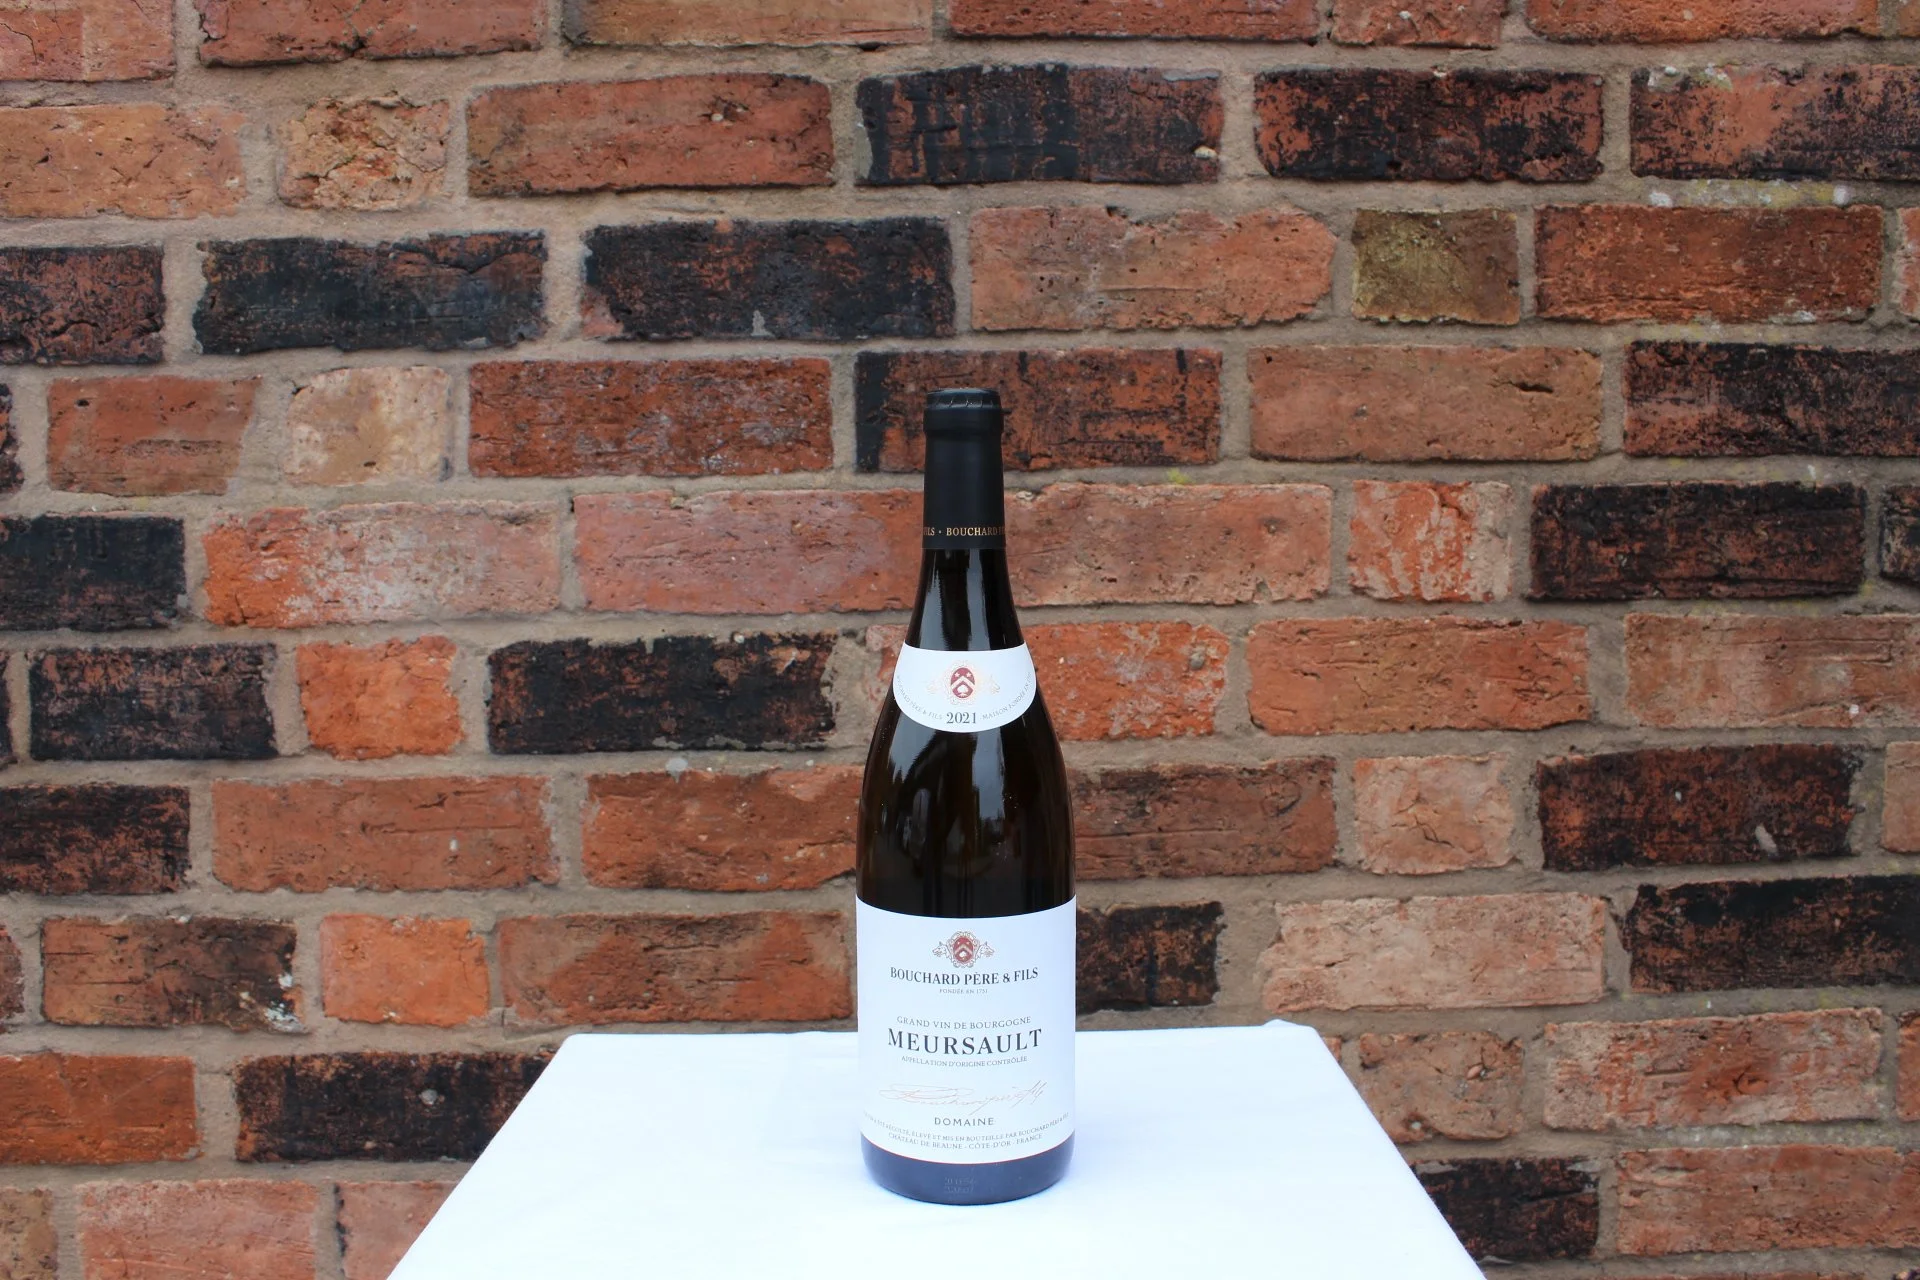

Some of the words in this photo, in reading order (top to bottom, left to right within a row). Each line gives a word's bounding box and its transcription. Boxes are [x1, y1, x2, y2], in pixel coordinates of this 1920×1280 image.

[946, 527, 998, 536] BOUCHARD
[946, 711, 976, 724] 2021
[982, 705, 1008, 719] MAISON
[890, 966, 961, 985] BOUCHARD
[964, 972, 999, 985] PÈRE
[1002, 973, 1011, 983] &
[1014, 966, 1039, 982] FILS
[896, 1015, 930, 1028] GRAND
[933, 1021, 951, 1029] VIN
[970, 1015, 1032, 1029] BOURGOGNE
[888, 1028, 1042, 1055] MEURSAULT
[901, 1055, 947, 1067] APPELLATION
[986, 1055, 1028, 1067] CONTRÔLÉE
[934, 1117, 994, 1126] DOMAINE
[1019, 1123, 1049, 1136] BOUCHARD
[888, 1132, 919, 1144] CHÂTEAU
[932, 1141, 963, 1149] BEAUNE
[1017, 1133, 1042, 1145] FRANCE
